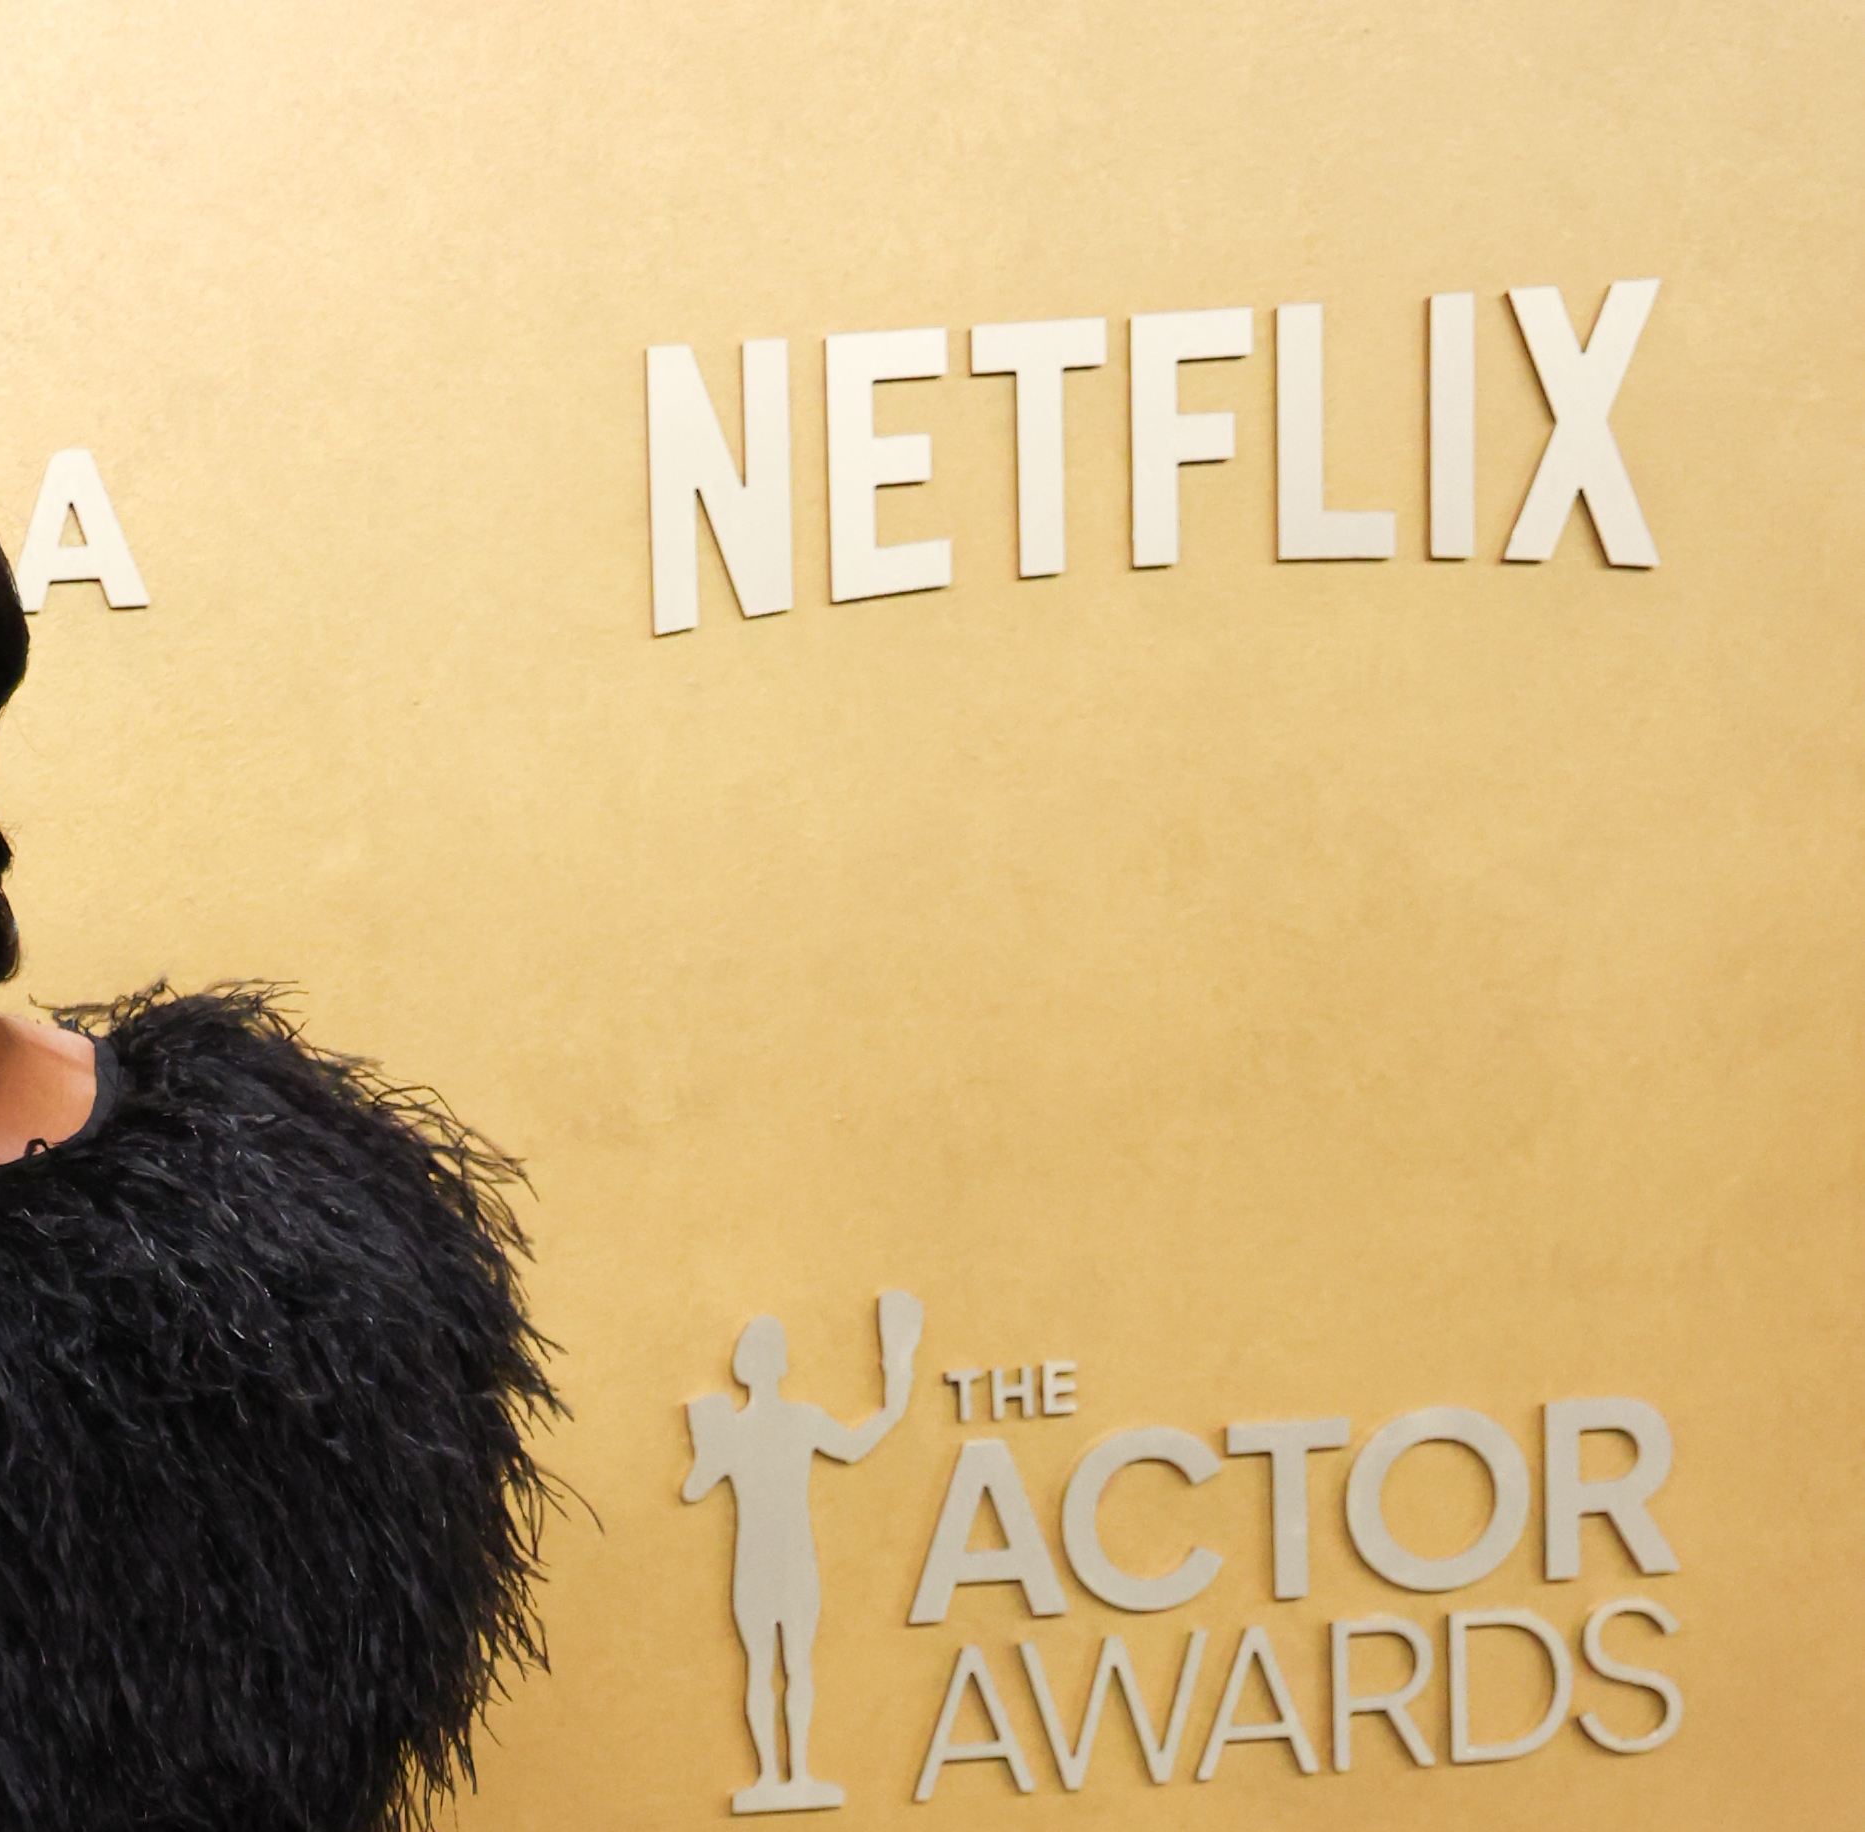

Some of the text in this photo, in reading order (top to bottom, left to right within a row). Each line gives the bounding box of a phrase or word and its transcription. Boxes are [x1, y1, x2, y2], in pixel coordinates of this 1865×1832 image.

[646, 278, 1662, 637] NETFLIX
[944, 1360, 1078, 1424] THE
[907, 1397, 1681, 1626] ACTOR
[913, 1597, 1683, 1802] AWARDS
